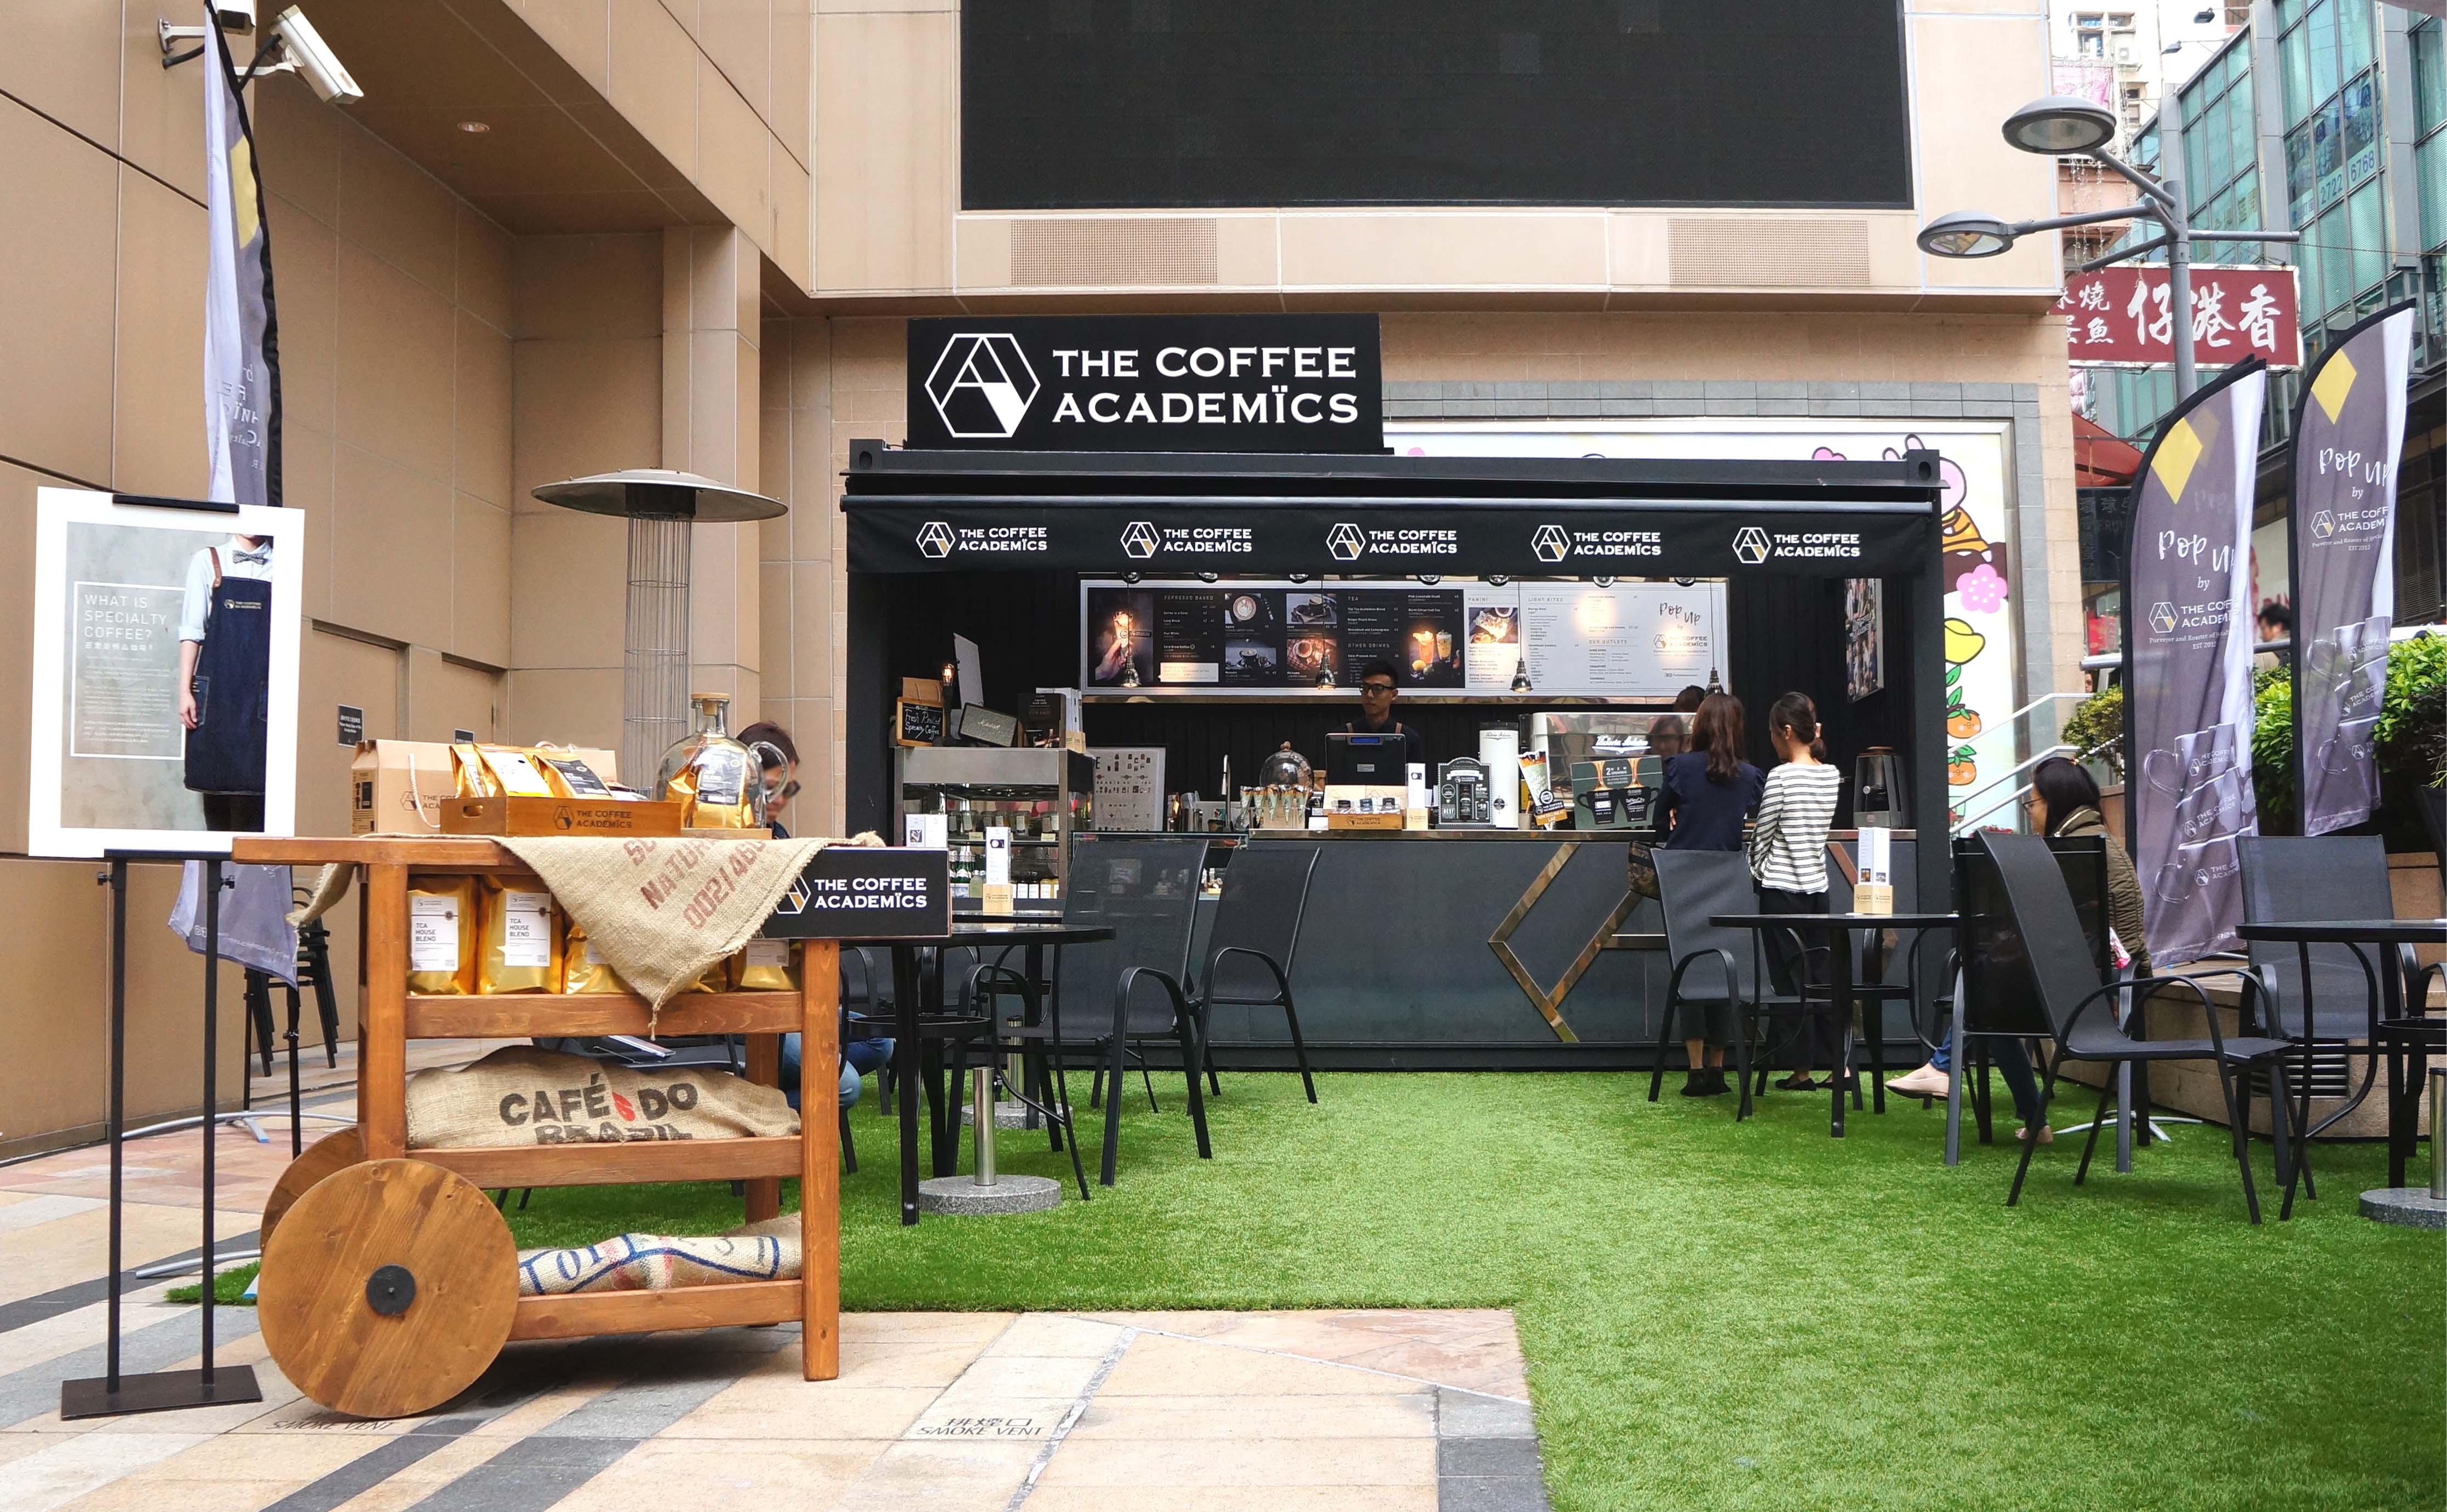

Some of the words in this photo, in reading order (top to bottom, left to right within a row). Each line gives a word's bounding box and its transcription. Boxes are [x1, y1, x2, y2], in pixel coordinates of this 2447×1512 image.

[2320, 174, 2343, 204] 2722
[2351, 151, 2374, 181] 6768
[1053, 349, 1139, 378] THE
[1155, 346, 1357, 378] COFFEE
[1052, 385, 1359, 424] ACADEMÏCS
[2319, 448, 2360, 478] Pop
[2351, 486, 2363, 500] by
[2337, 512, 2358, 521] THE
[959, 528, 985, 538] THE
[988, 527, 1047, 539] COFFEE
[1163, 529, 1189, 539] THE
[1193, 528, 1252, 539] COFFEE
[1369, 530, 1395, 540] THE
[1398, 530, 1457, 541] COFFEE
[1573, 532, 1600, 542] THE
[1602, 531, 1661, 543] COFFEE
[1774, 534, 1800, 544] THE
[1802, 534, 1860, 545] COFFEE
[2159, 530, 2207, 565] Pop
[2197, 576, 2210, 592] by
[84, 594, 127, 606] WHAT
[134, 597, 147, 608] IS
[1659, 602, 1682, 618] Pop
[2180, 604, 2204, 615] THE
[84, 610, 167, 625] SPECIALTY
[1684, 611, 1700, 626] Up
[84, 626, 152, 640] COFFEE?
[577, 810, 593, 818] THE
[595, 811, 632, 819] COFFEE
[2210, 864, 2227, 873] THE
[815, 879, 846, 891] THE
[852, 877, 927, 892] COFFEE
[499, 1073, 611, 1127] CAFÉ
[638, 1083, 698, 1121] DO
[267, 1420, 337, 1429] SMOKE
[343, 1421, 400, 1430] VENT
[917, 1427, 989, 1435] SMOKE
[997, 1427, 1045, 1435] VENT
